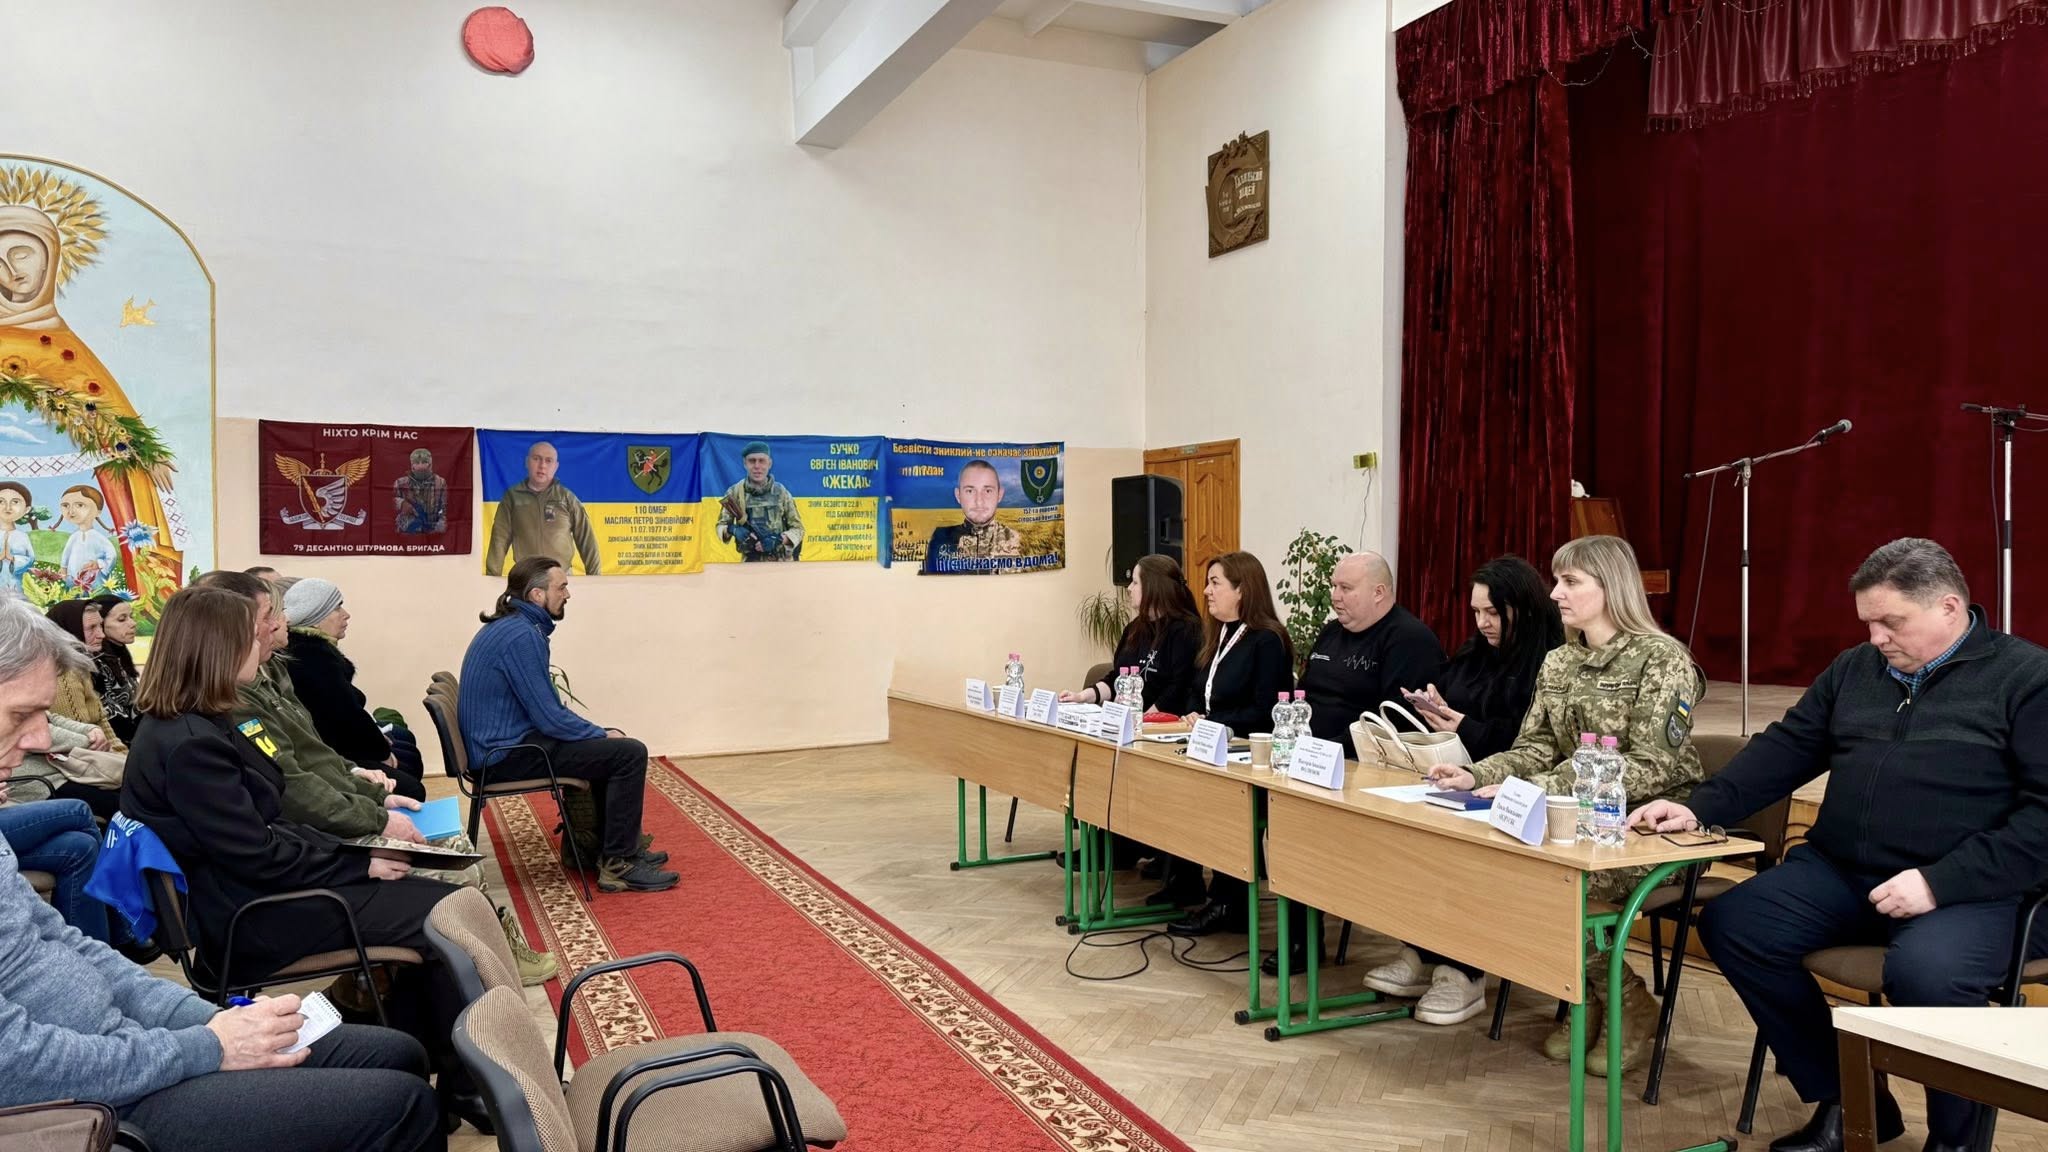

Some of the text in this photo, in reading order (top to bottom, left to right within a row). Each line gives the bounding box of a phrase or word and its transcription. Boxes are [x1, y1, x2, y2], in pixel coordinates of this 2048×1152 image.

[322, 428, 418, 440] НІХТО КРІМ НАС
[830, 443, 859, 455] БУЧКО
[892, 443, 932, 455] Безвісти
[810, 459, 879, 470] ЄВГЕН ІВАНОВИЧ
[635, 506, 647, 514] 110
[633, 516, 654, 525] ПЕТРО
[306, 544, 354, 553] ДЕСАНТНО
[356, 544, 404, 552] ШТУРМОВА
[407, 544, 445, 552] БРИГАДА
